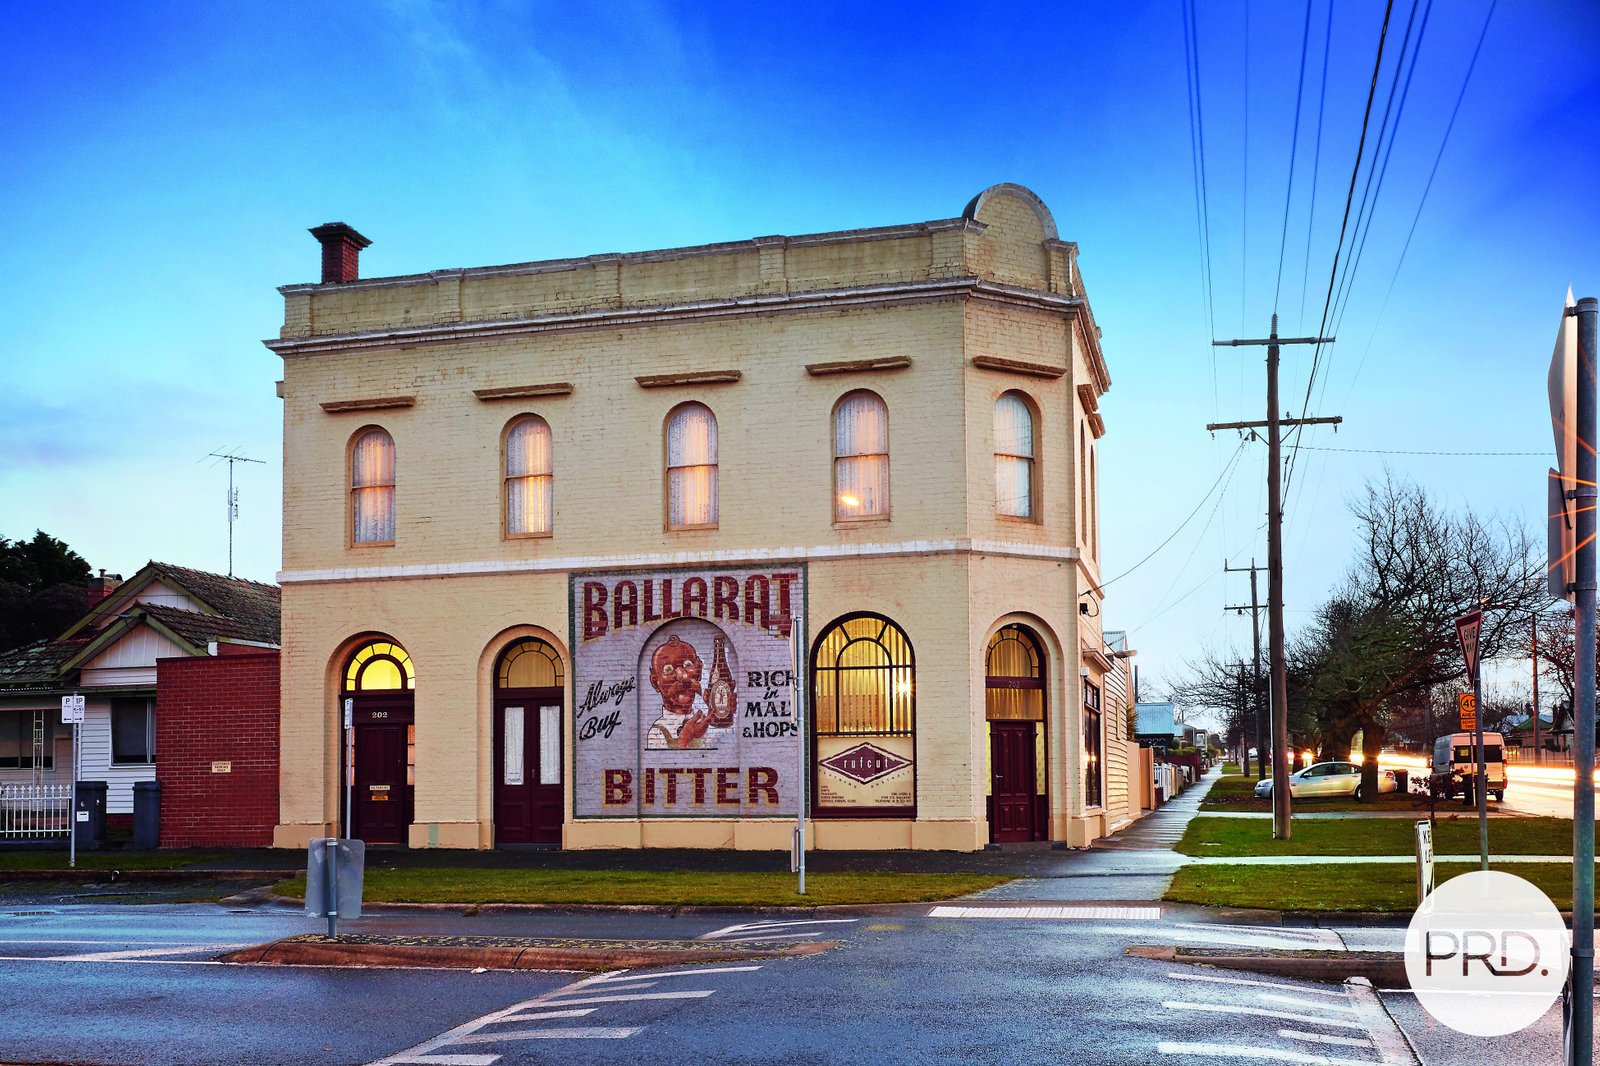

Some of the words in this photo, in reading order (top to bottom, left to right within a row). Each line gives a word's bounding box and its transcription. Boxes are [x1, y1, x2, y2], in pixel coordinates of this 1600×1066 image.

[583, 573, 798, 641] BALLARAT
[1464, 626, 1476, 640] GIVE
[577, 676, 636, 718] Always
[763, 686, 780, 700] in
[744, 701, 791, 717] MAL
[1463, 699, 1476, 708] 40
[371, 711, 388, 719] 202
[579, 710, 622, 740] Buy
[844, 757, 889, 769] rufcut
[603, 766, 779, 808] BITTER
